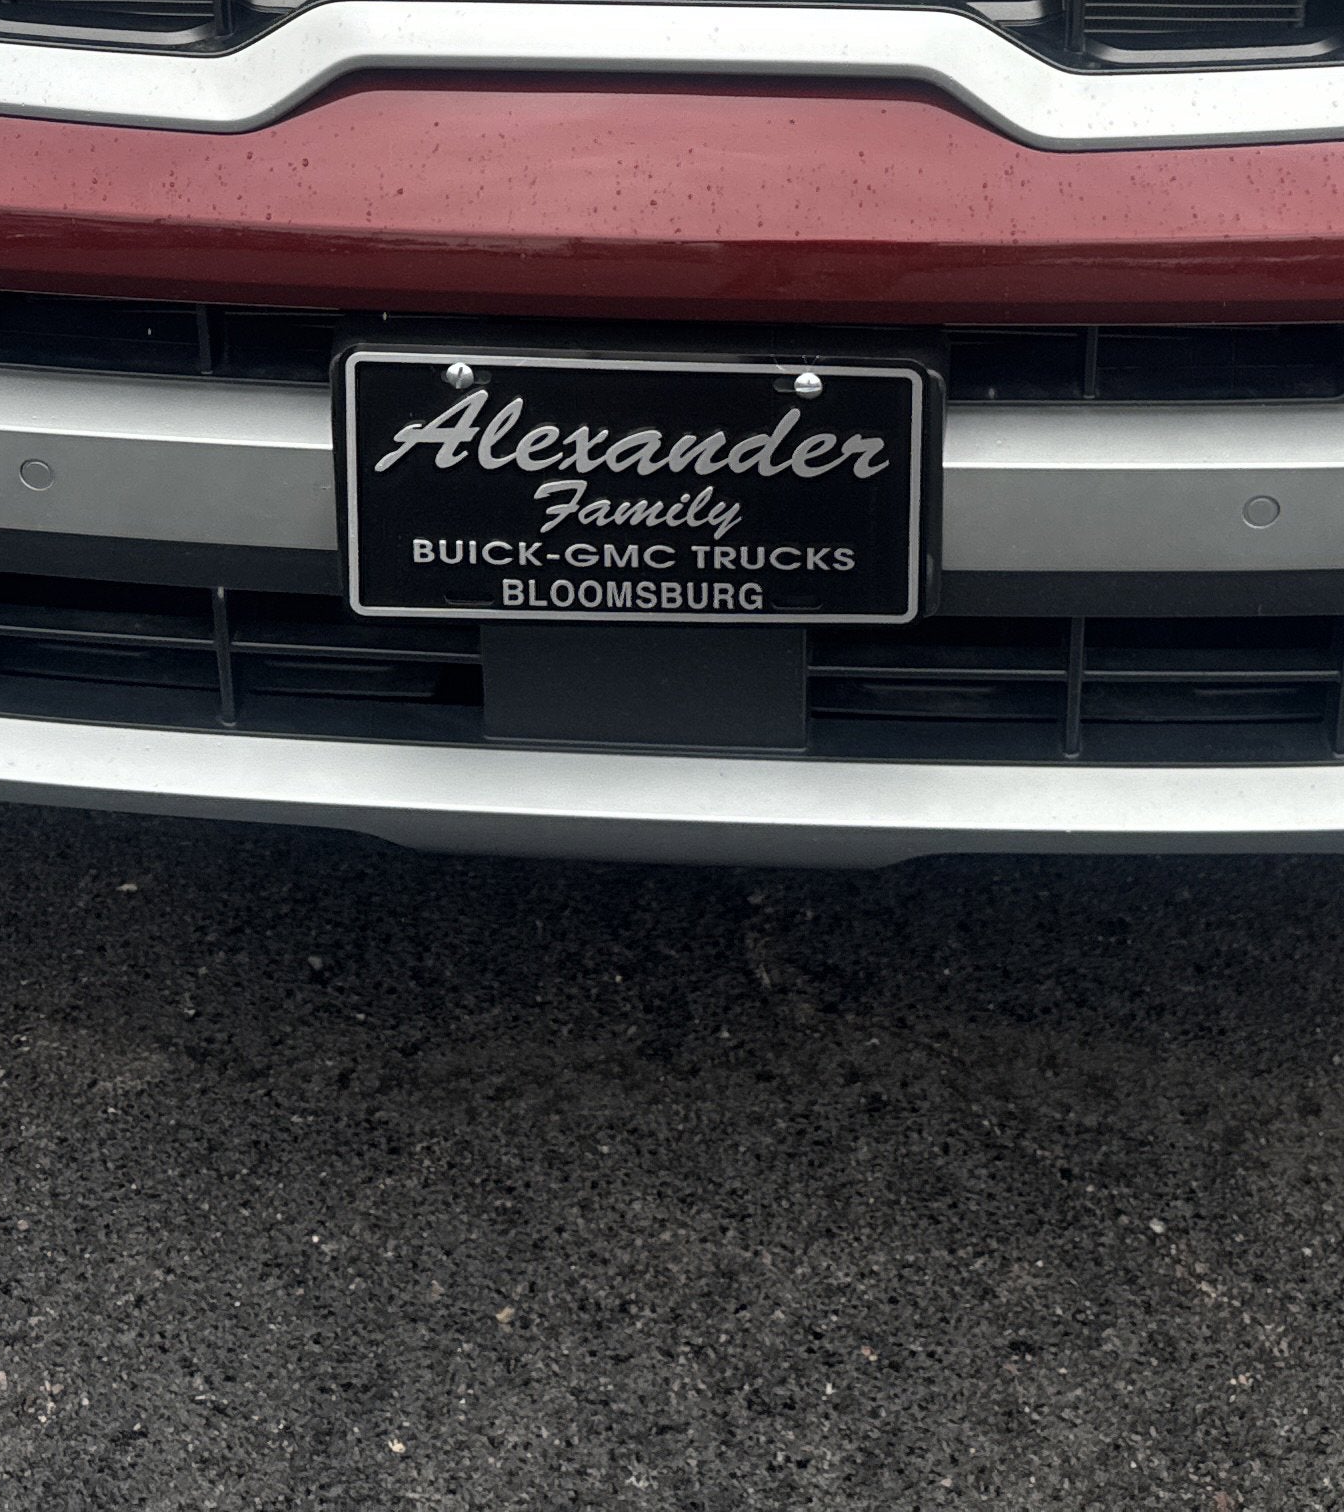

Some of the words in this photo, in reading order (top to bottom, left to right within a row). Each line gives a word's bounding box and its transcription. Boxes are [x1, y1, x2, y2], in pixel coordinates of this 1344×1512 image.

[374, 389, 890, 479] Alexander
[532, 479, 742, 540] Family
[412, 539, 677, 570] BUICK-GMC
[692, 545, 856, 571] TRUCKS
[501, 578, 764, 610] BLOOMSBURG
